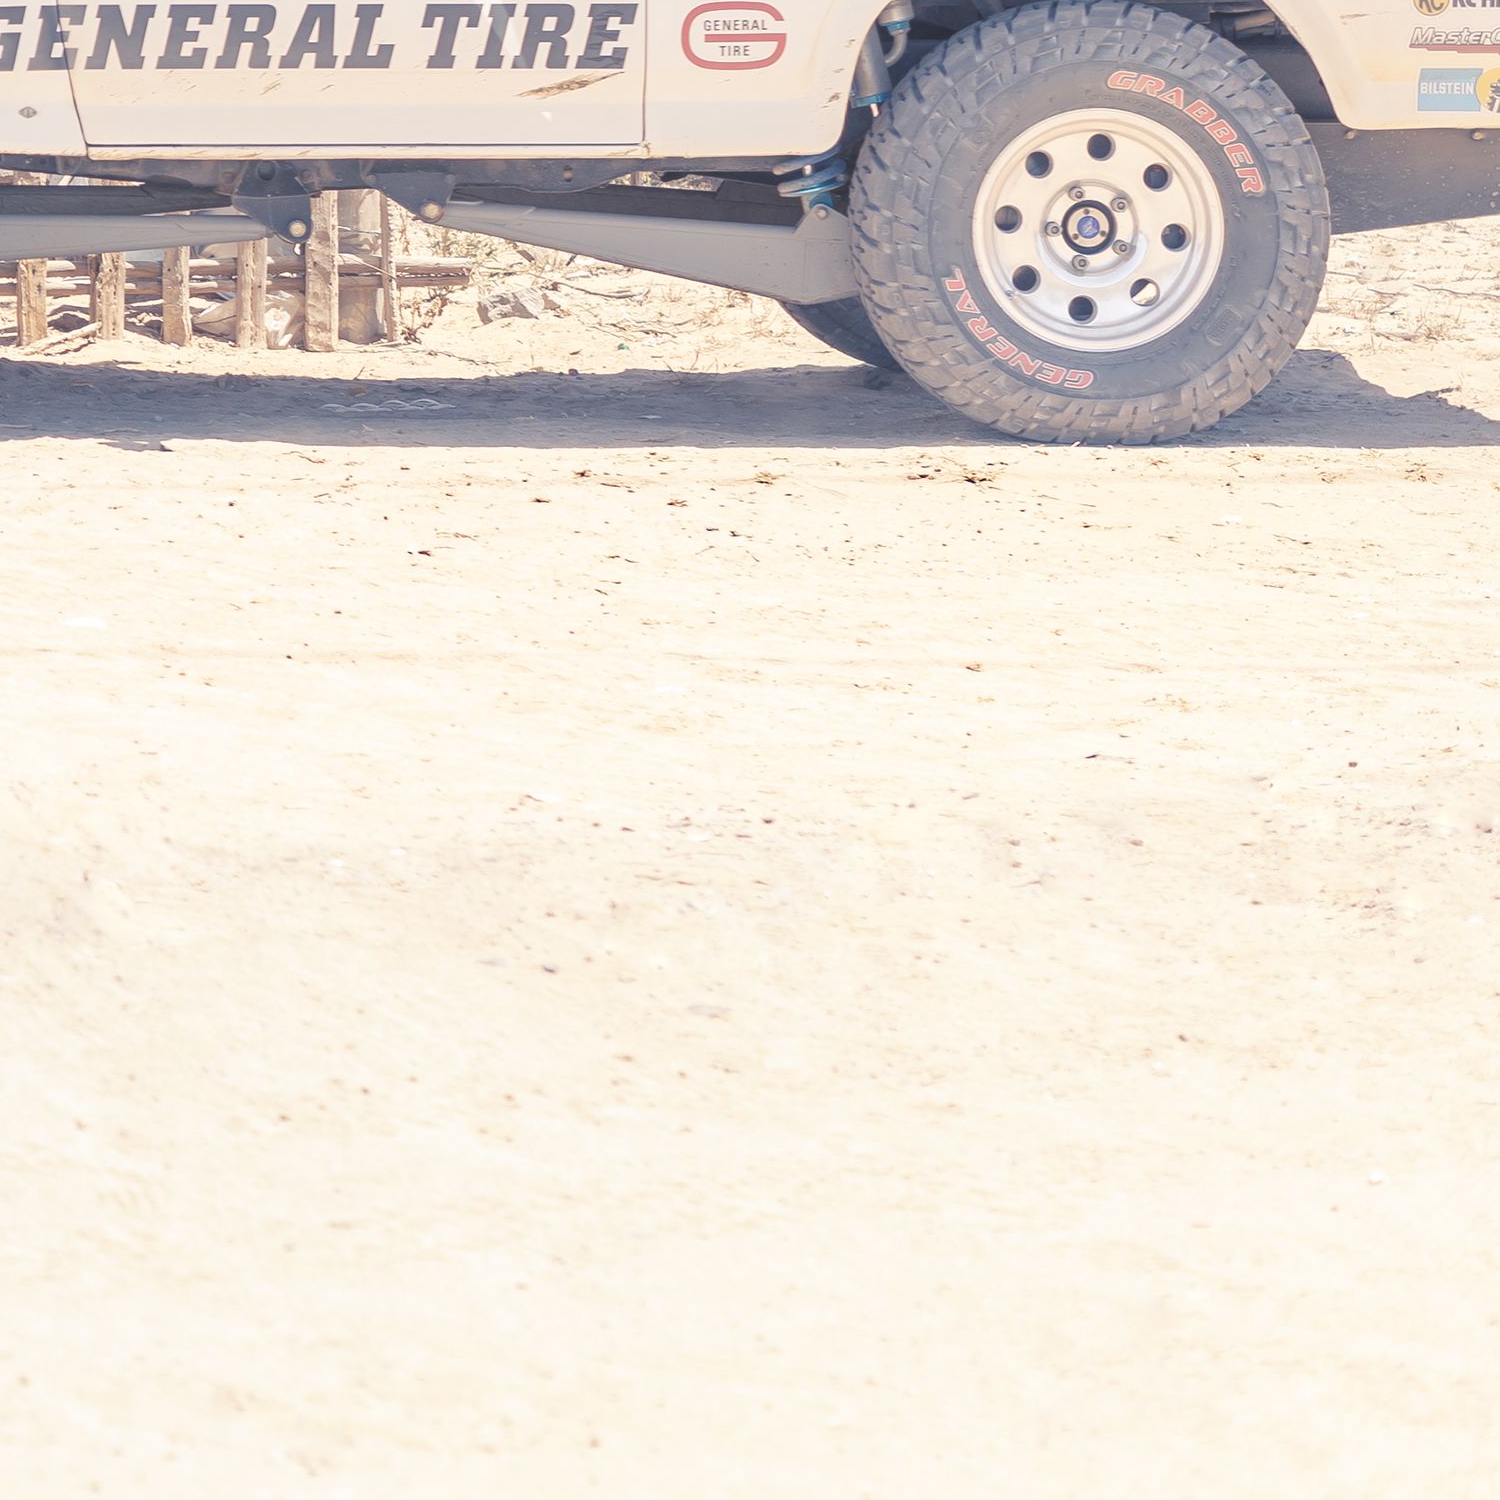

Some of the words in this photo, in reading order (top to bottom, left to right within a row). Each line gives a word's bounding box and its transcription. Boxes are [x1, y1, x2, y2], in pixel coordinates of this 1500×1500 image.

[419, 2, 639, 71] TIRE
[703, 19, 768, 31] GENERAL
[719, 45, 750, 56] TIRE
[1420, 82, 1475, 94] BILSTEIN
[1107, 70, 1265, 194] GRABBER
[942, 268, 1094, 389] GENERAL
